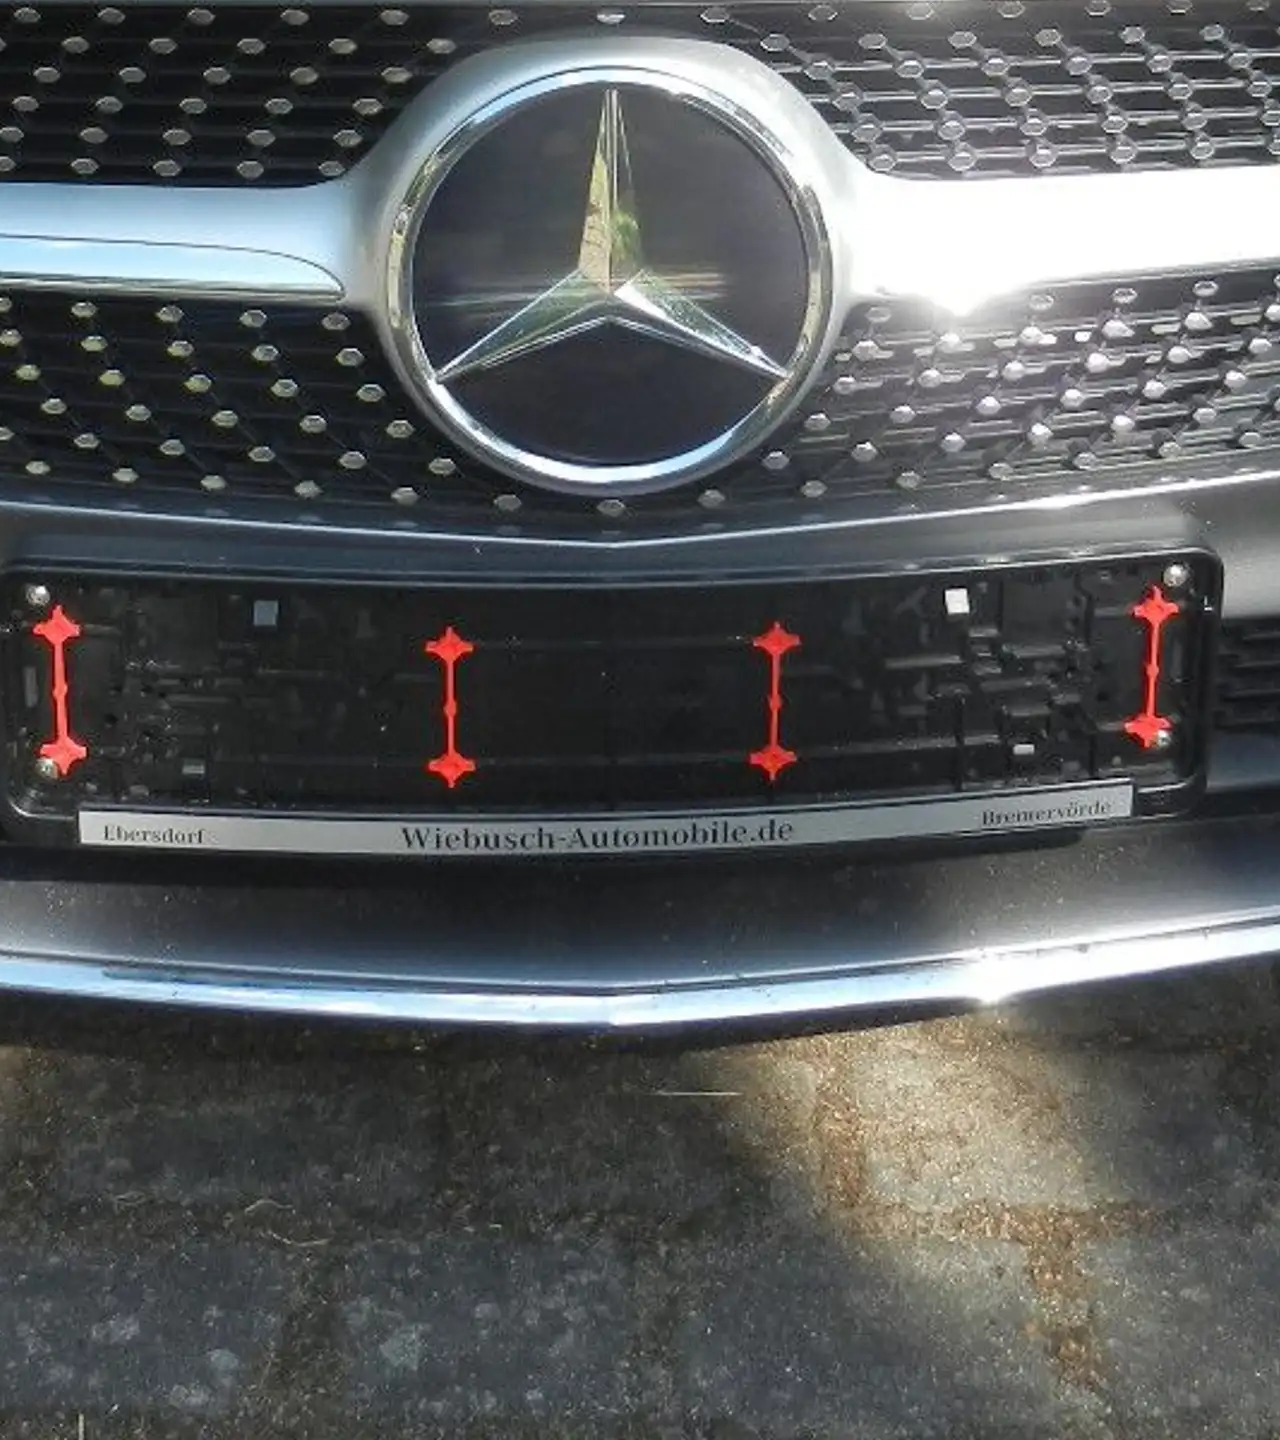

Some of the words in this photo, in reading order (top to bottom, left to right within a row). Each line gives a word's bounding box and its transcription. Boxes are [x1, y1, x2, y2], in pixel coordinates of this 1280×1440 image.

[103, 825, 206, 844] Ebersdorf
[401, 820, 794, 850] Wiebusch-Automobile.de
[982, 800, 1112, 826] Bremervörde
